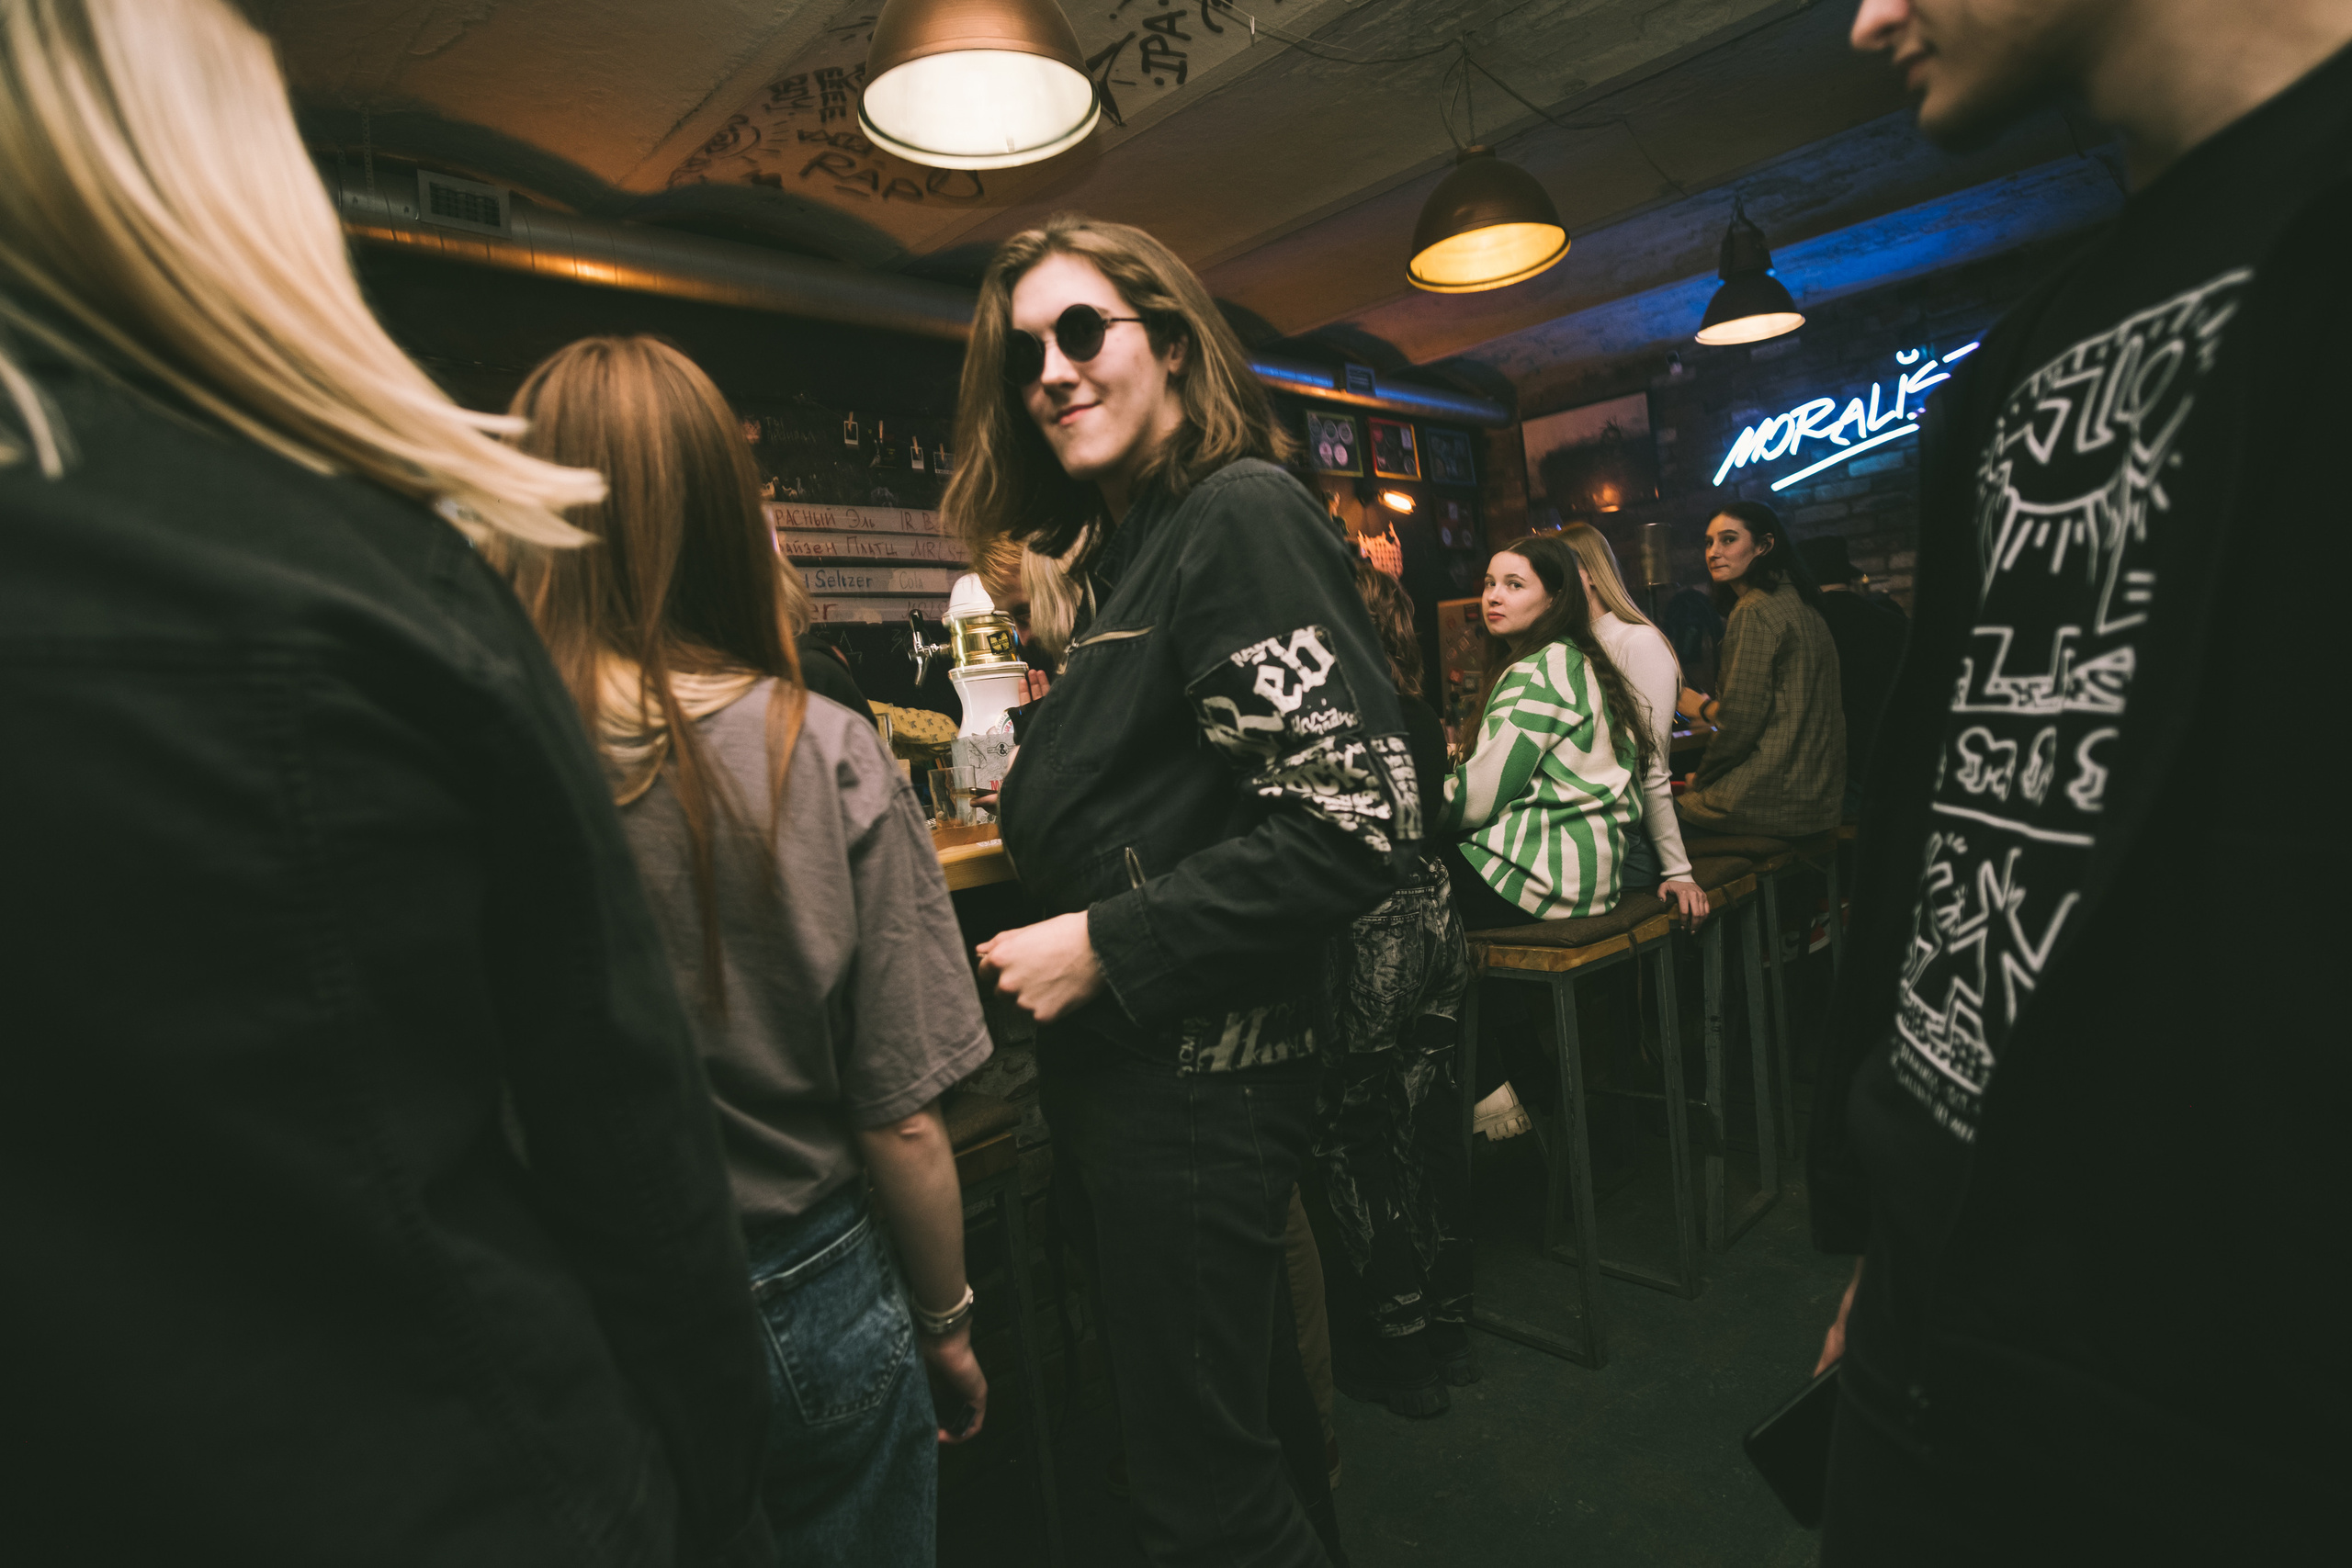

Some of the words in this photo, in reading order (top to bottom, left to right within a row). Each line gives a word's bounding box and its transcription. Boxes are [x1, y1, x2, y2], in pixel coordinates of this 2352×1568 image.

[1139, 9, 1193, 85] IPA
[775, 507, 836, 527] РАСНЫЙ
[845, 508, 876, 529] Эль
[814, 569, 874, 589] Seltzer
